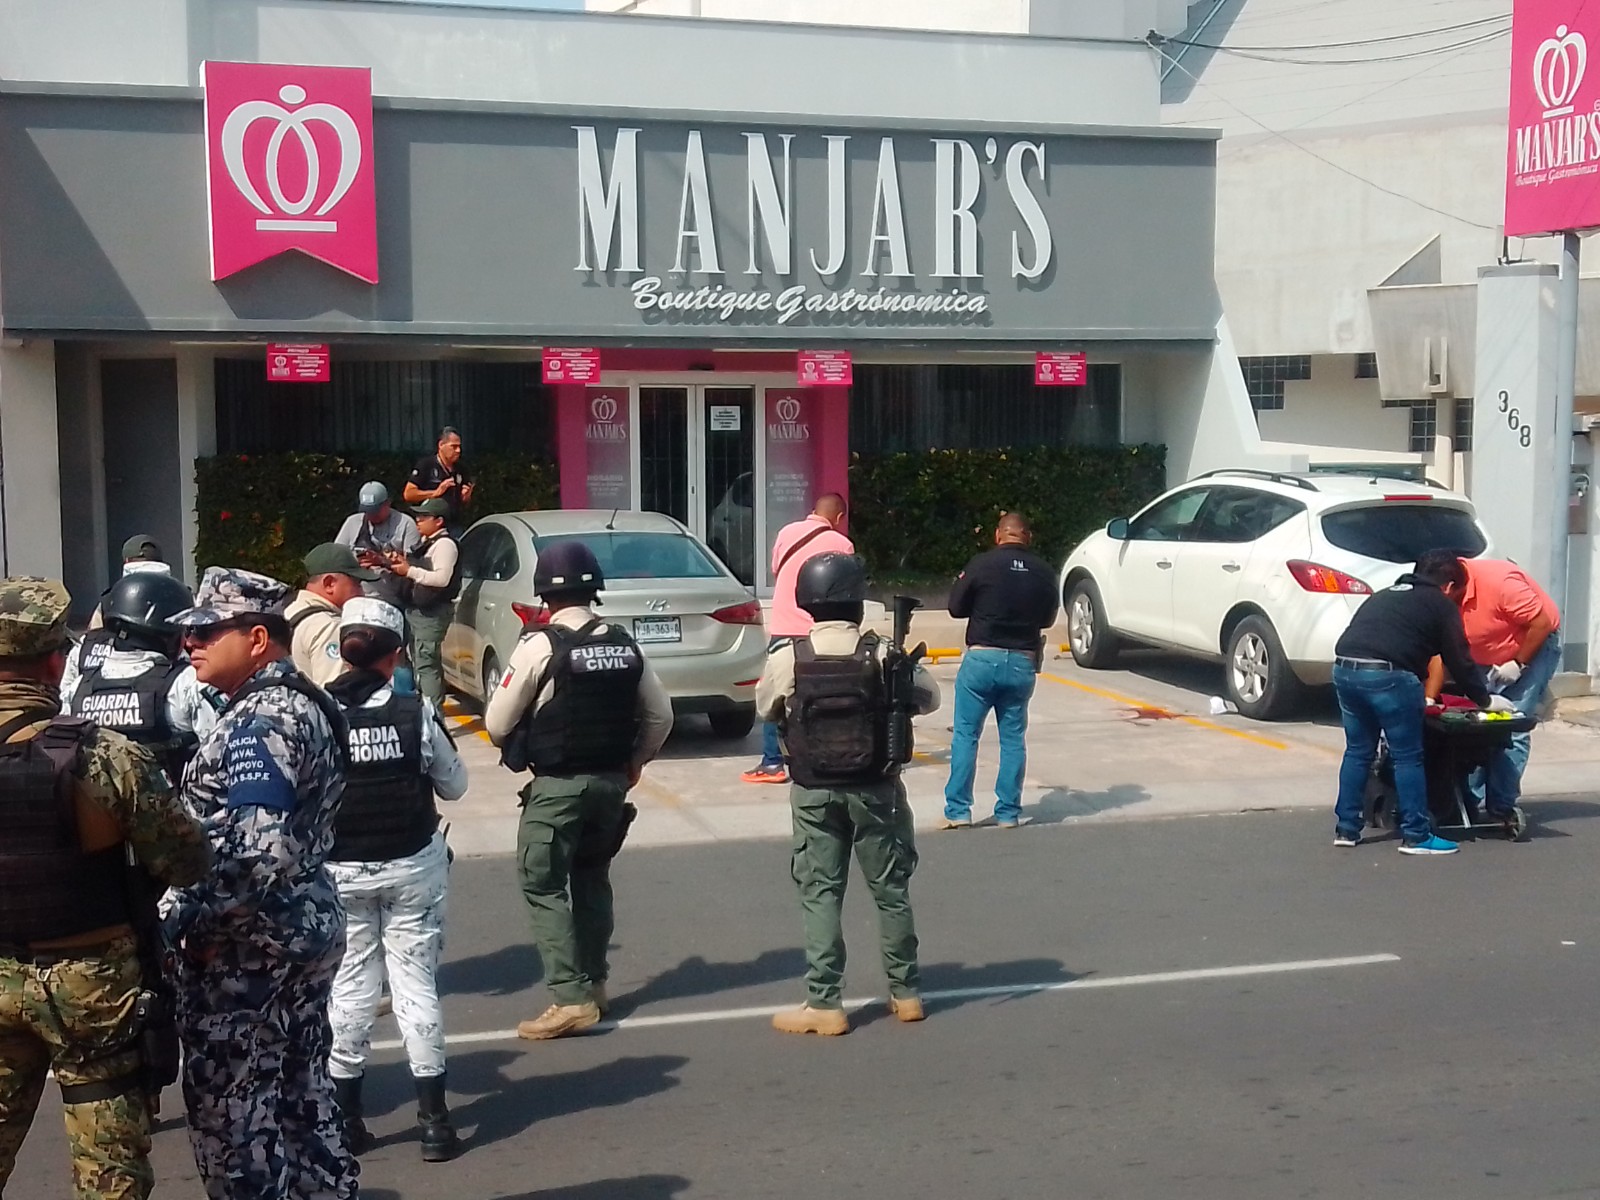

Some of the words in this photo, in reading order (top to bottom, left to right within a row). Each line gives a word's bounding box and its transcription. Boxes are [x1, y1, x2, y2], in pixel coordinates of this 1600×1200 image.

[1514, 111, 1600, 175] MANJAR'S
[571, 126, 1052, 278] MANJAR'S
[631, 276, 773, 320] Boutique
[1498, 390, 1531, 447] 368
[91, 643, 111, 658] GUA
[571, 645, 636, 660] FUERZA
[586, 658, 629, 671] CIVIL
[82, 692, 140, 712] GUARDIA
[349, 725, 400, 746] ARDIA
